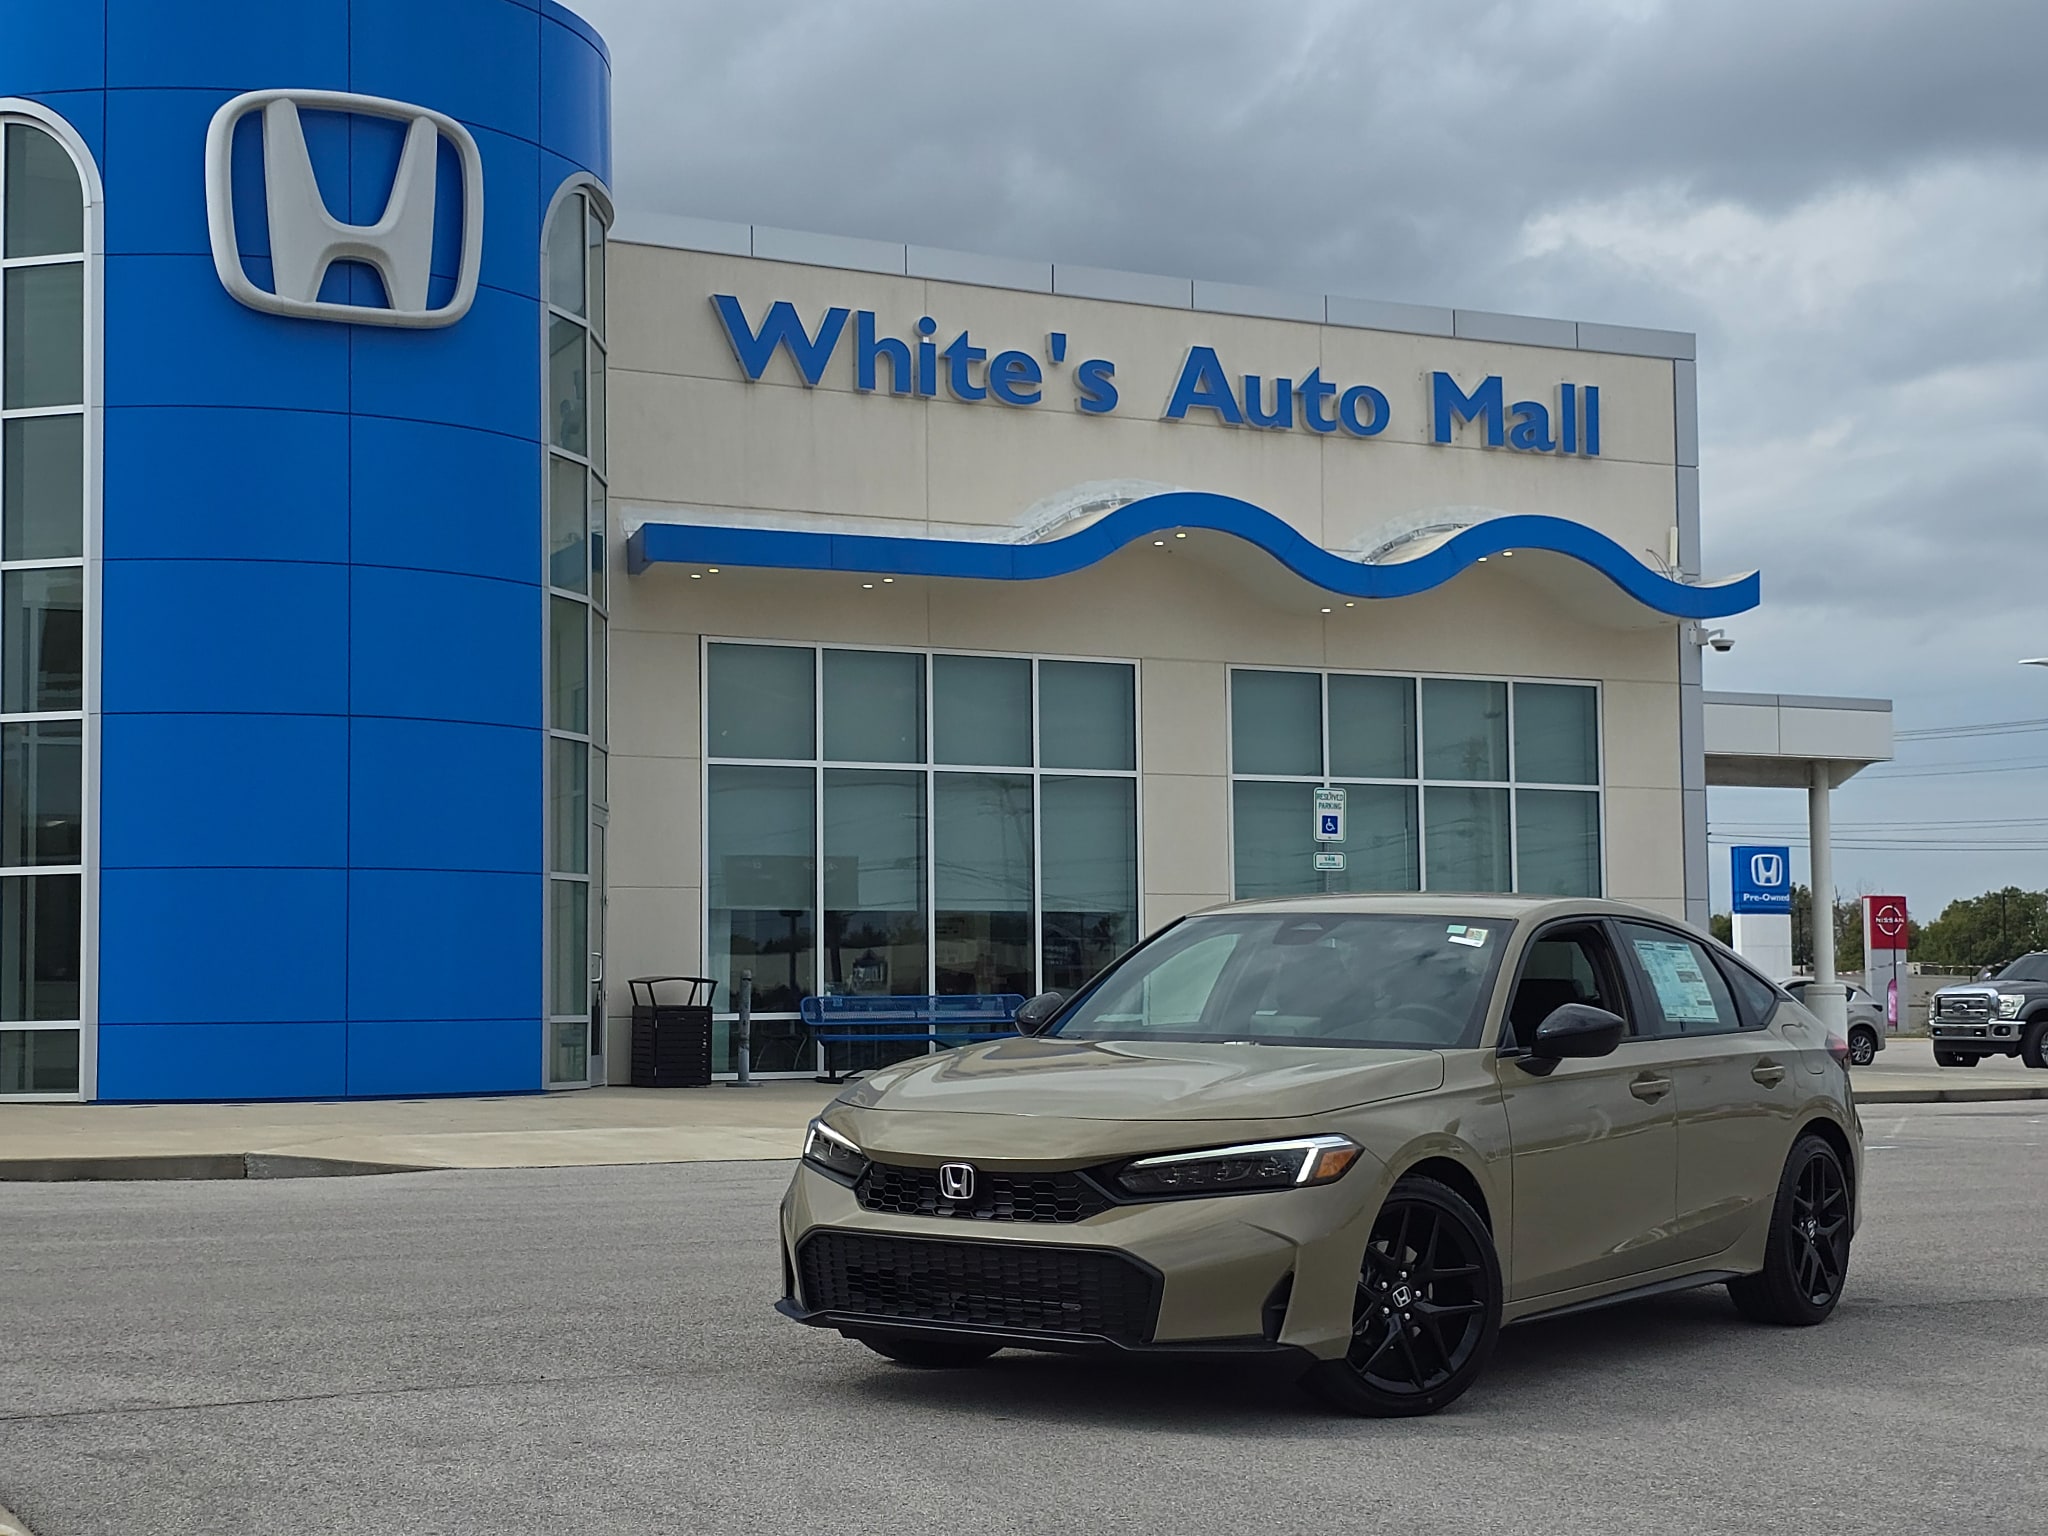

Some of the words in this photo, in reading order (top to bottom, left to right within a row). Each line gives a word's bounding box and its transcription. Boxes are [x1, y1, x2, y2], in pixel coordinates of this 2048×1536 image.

[711, 293, 1119, 415] White's
[1163, 345, 1390, 437] Auto
[1430, 371, 1600, 457] Mall
[1743, 893, 1790, 902] Pre-Owned
